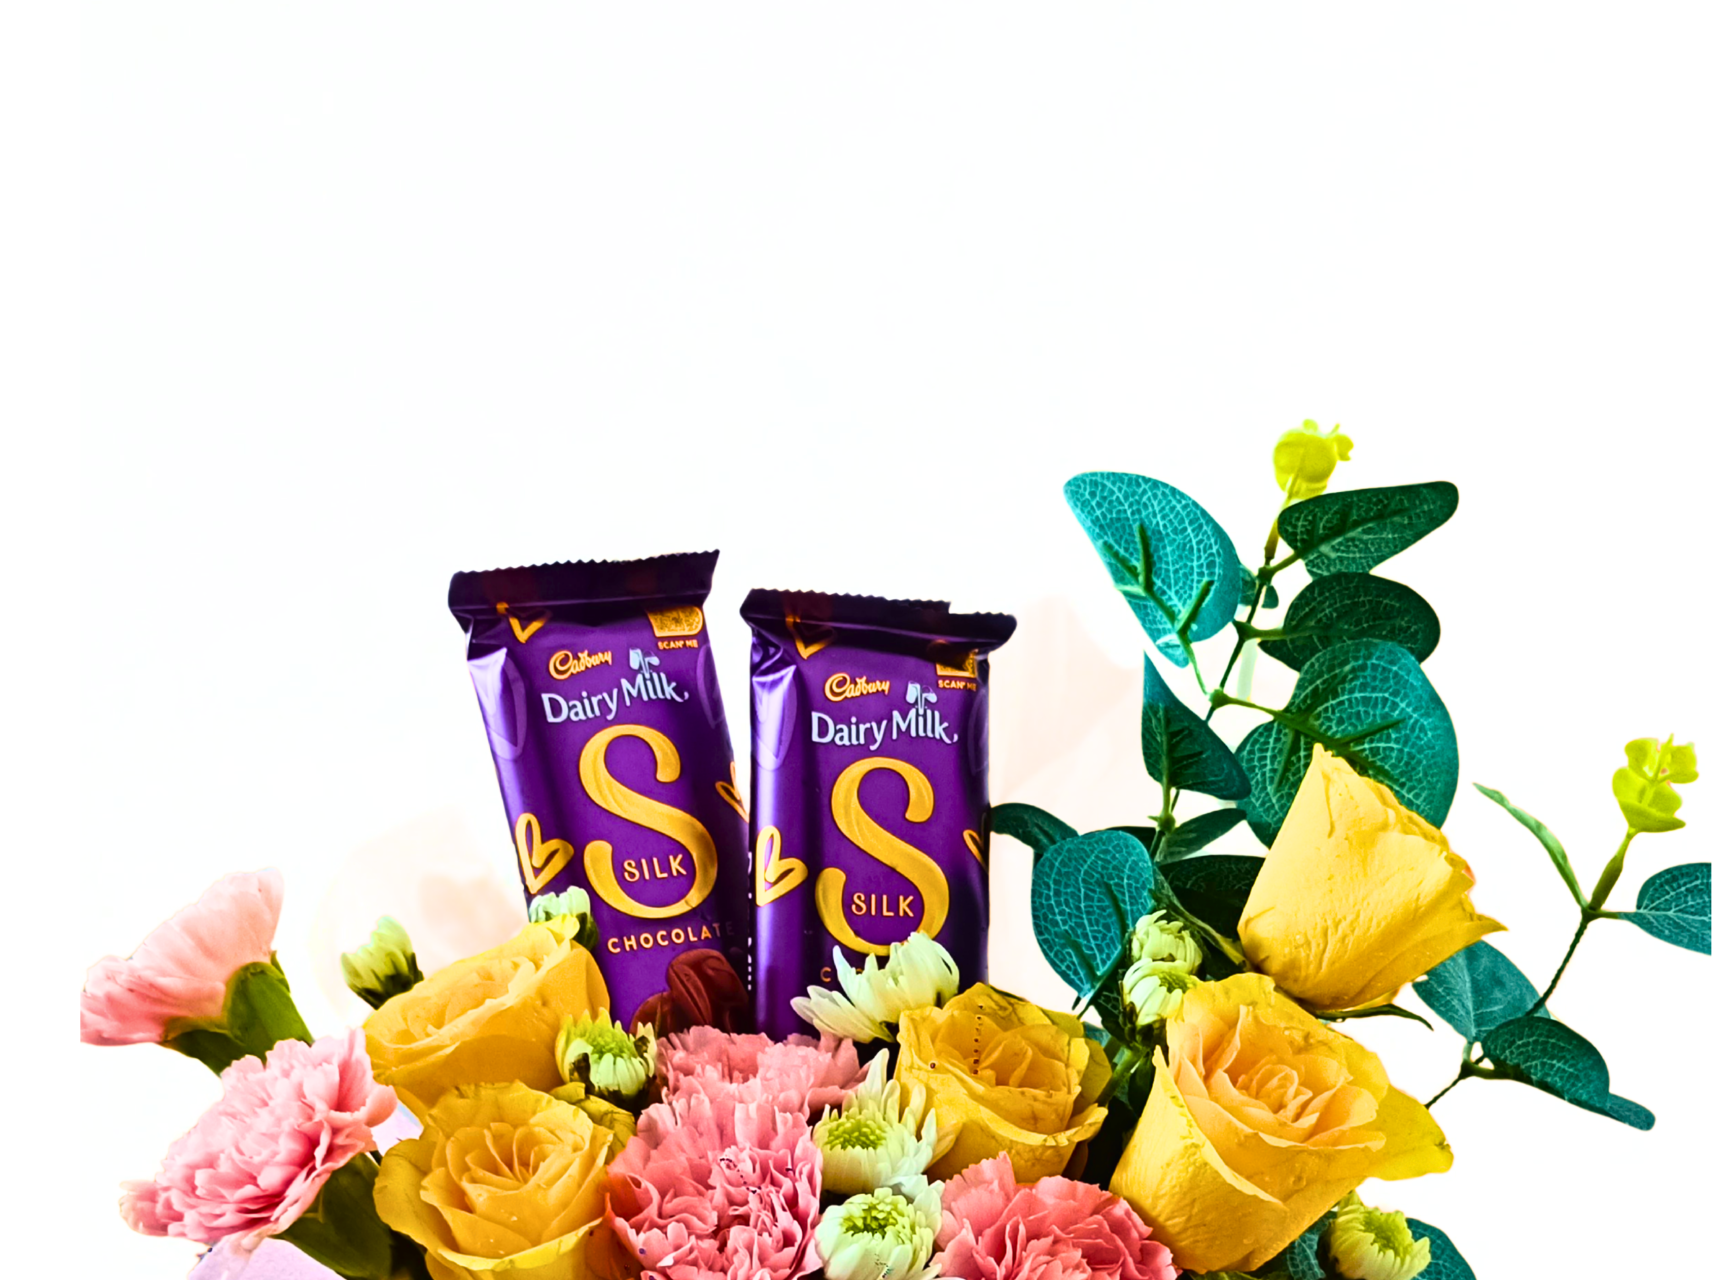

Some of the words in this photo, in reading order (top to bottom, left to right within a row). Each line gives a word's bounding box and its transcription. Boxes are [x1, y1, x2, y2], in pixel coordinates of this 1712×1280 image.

[549, 650, 612, 680] Cadbury
[541, 685, 618, 723] Dairy
[824, 672, 890, 702] Cadbury
[811, 710, 887, 751] Dairy
[578, 723, 718, 919] S
[622, 852, 688, 882] SILK
[815, 756, 950, 957] S
[851, 892, 915, 918] SILK
